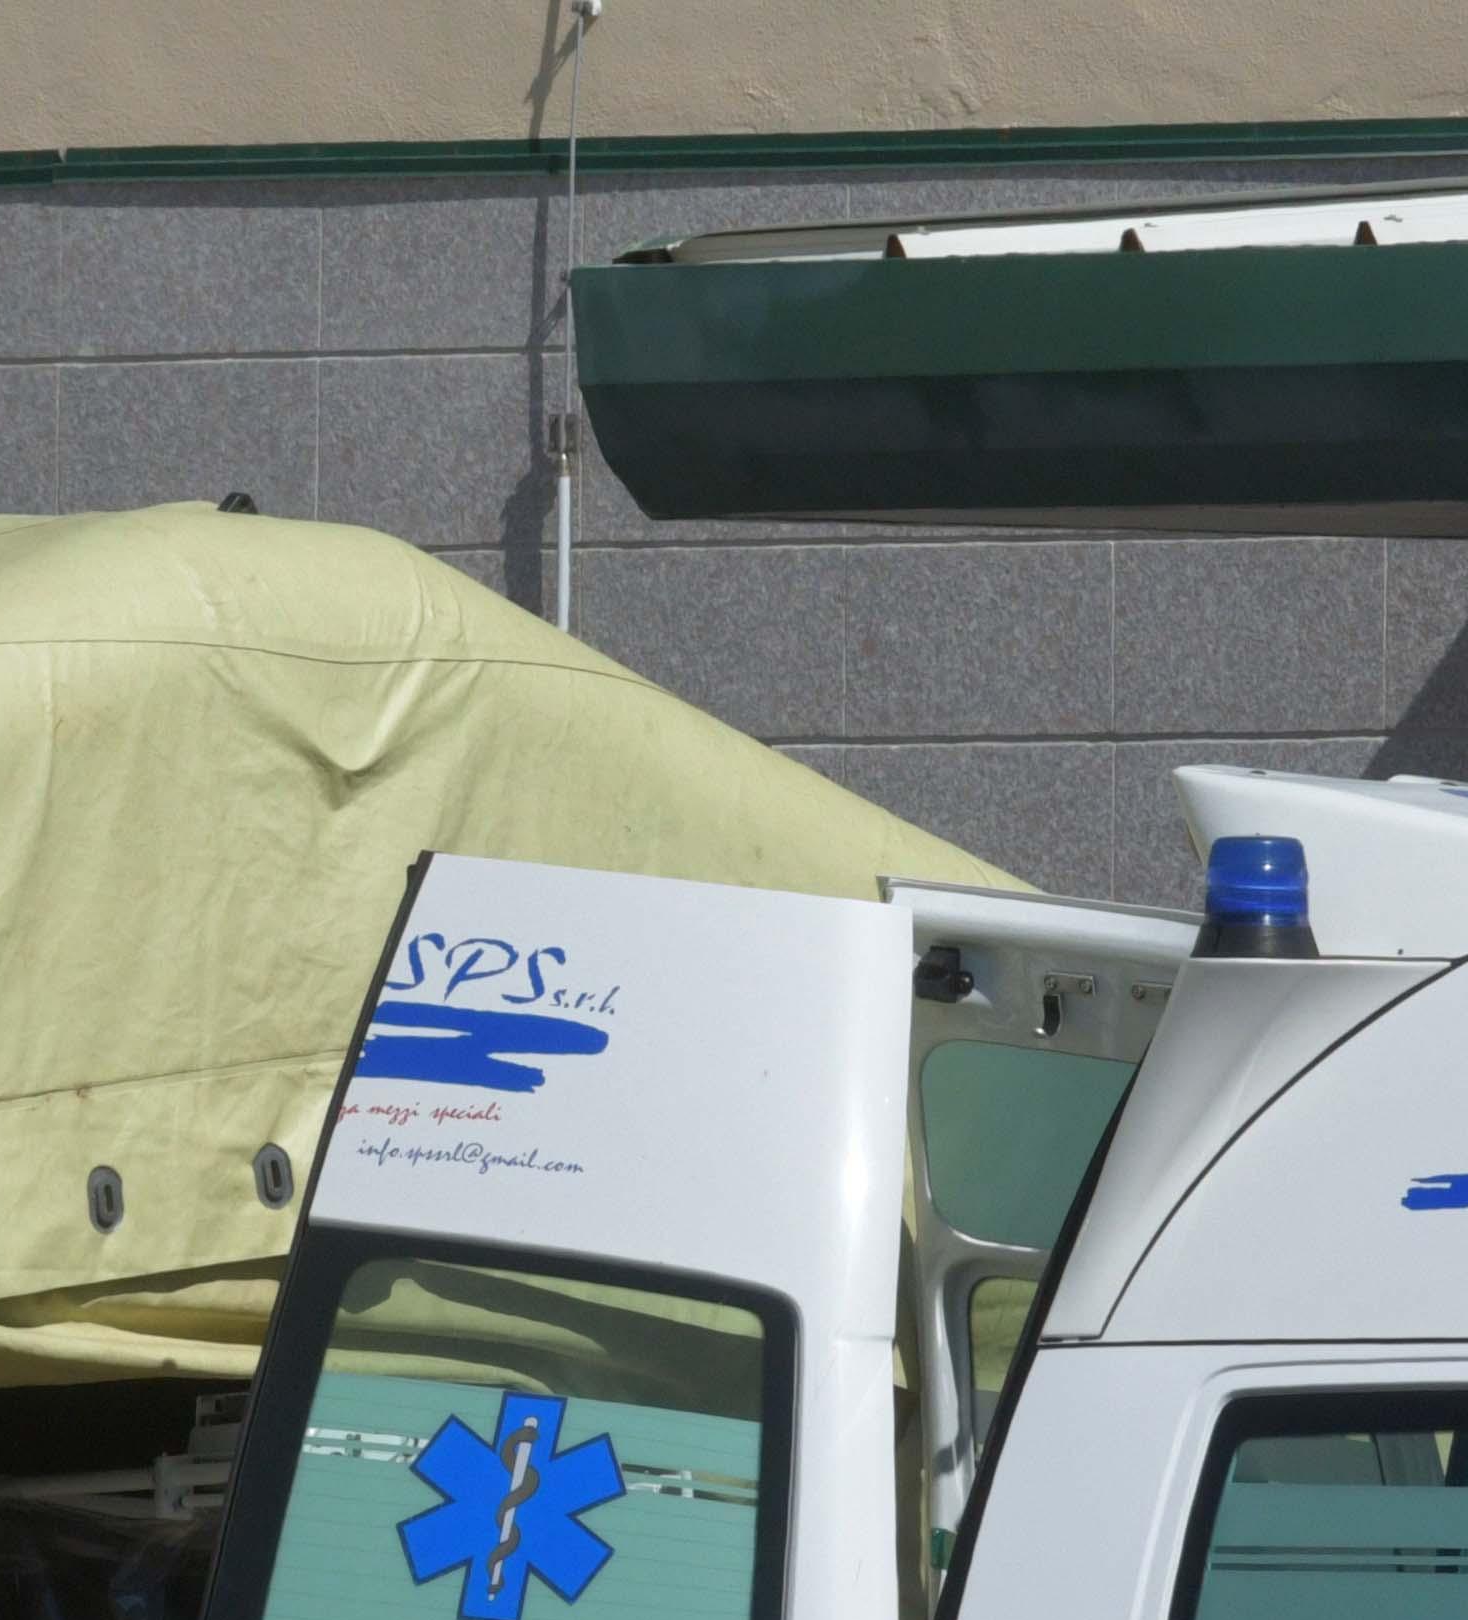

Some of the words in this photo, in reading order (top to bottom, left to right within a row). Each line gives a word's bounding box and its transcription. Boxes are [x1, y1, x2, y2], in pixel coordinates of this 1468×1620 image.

[382, 932, 567, 1004] SPS
[366, 1102, 421, 1126] mezzi
[429, 1101, 502, 1125] speciali
